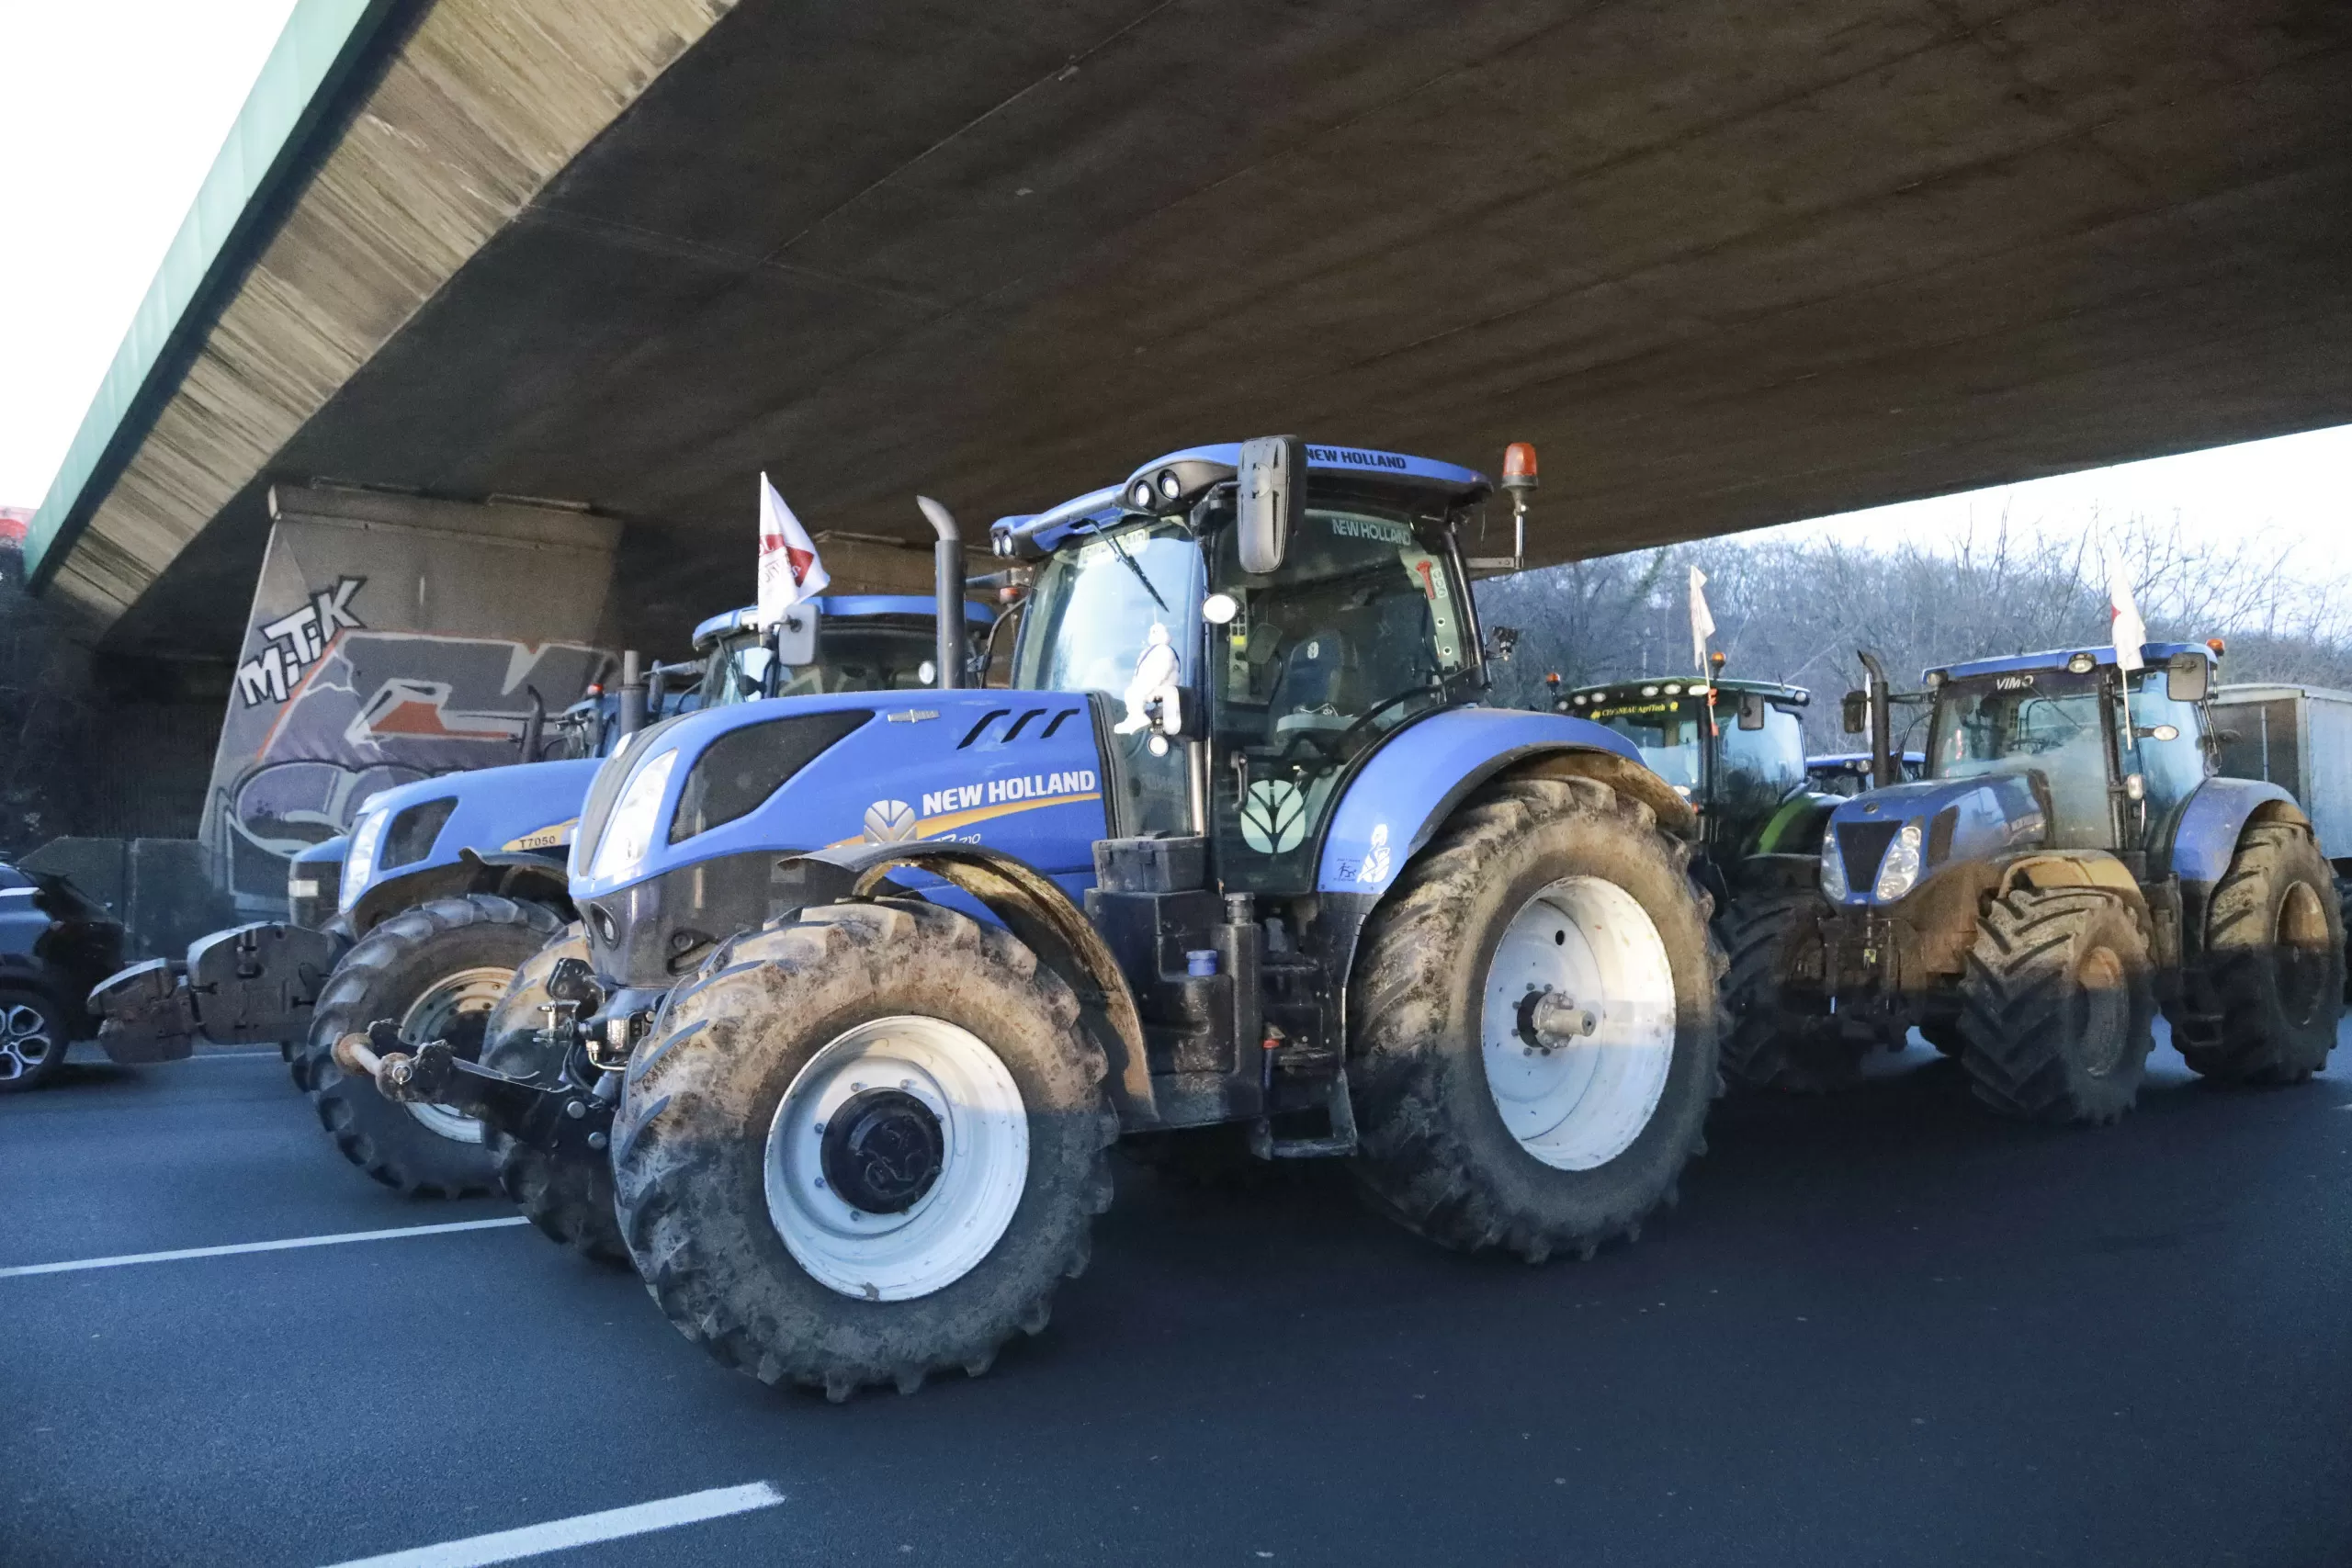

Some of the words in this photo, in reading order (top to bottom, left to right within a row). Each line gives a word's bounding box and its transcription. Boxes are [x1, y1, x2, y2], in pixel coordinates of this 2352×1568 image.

[1307, 448, 1338, 462] NEW
[1340, 451, 1407, 469] HOLLAND
[1332, 518, 1360, 536] NEW
[1361, 521, 1411, 546] HOLLAND
[922, 784, 983, 816] NEW
[989, 770, 1096, 804] HOLLAND
[519, 835, 556, 849] T7050
